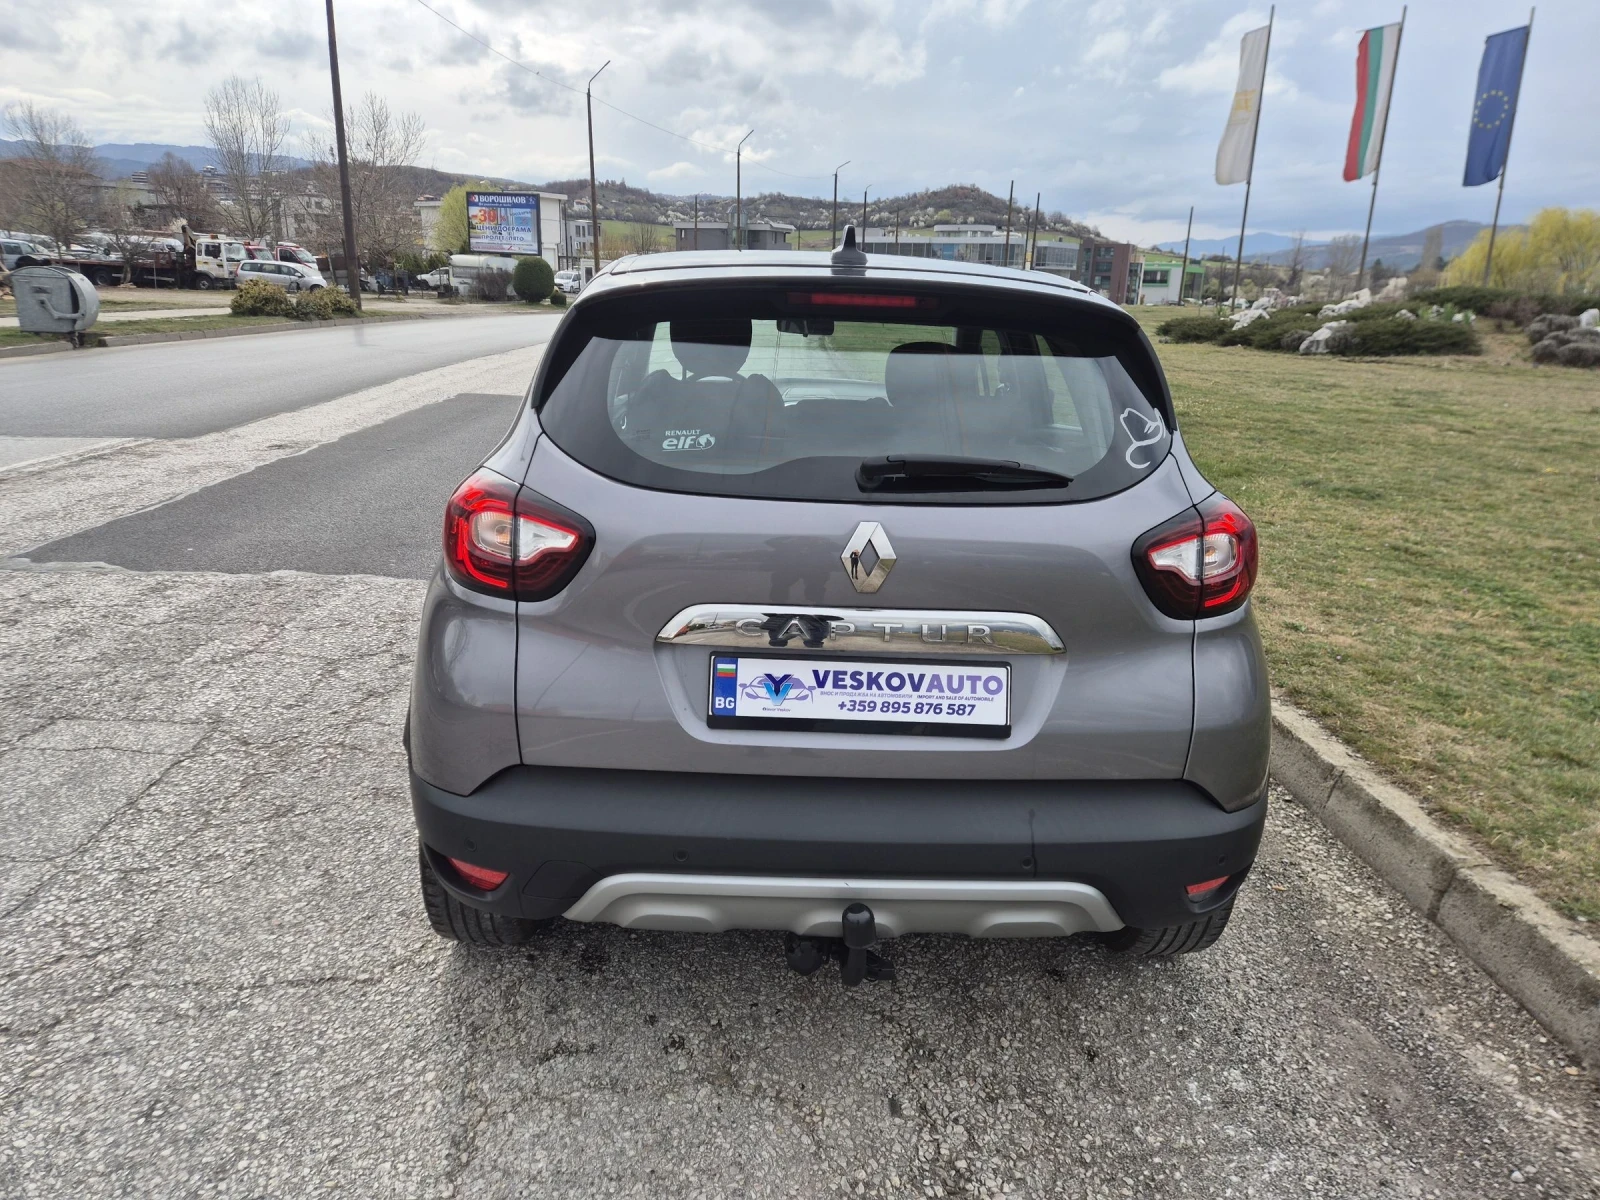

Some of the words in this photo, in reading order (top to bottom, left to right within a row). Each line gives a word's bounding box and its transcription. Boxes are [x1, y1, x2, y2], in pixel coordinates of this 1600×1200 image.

[479, 194, 526, 204] ВОРОШИЛОВ
[662, 436, 697, 450] elf
[735, 617, 994, 644] CAPTUR
[812, 669, 1004, 696] VESKOVAUTO
[715, 697, 735, 709] BG
[838, 699, 877, 713] +359
[880, 700, 911, 714] 895
[913, 702, 943, 715] 876
[946, 703, 976, 716] 587
